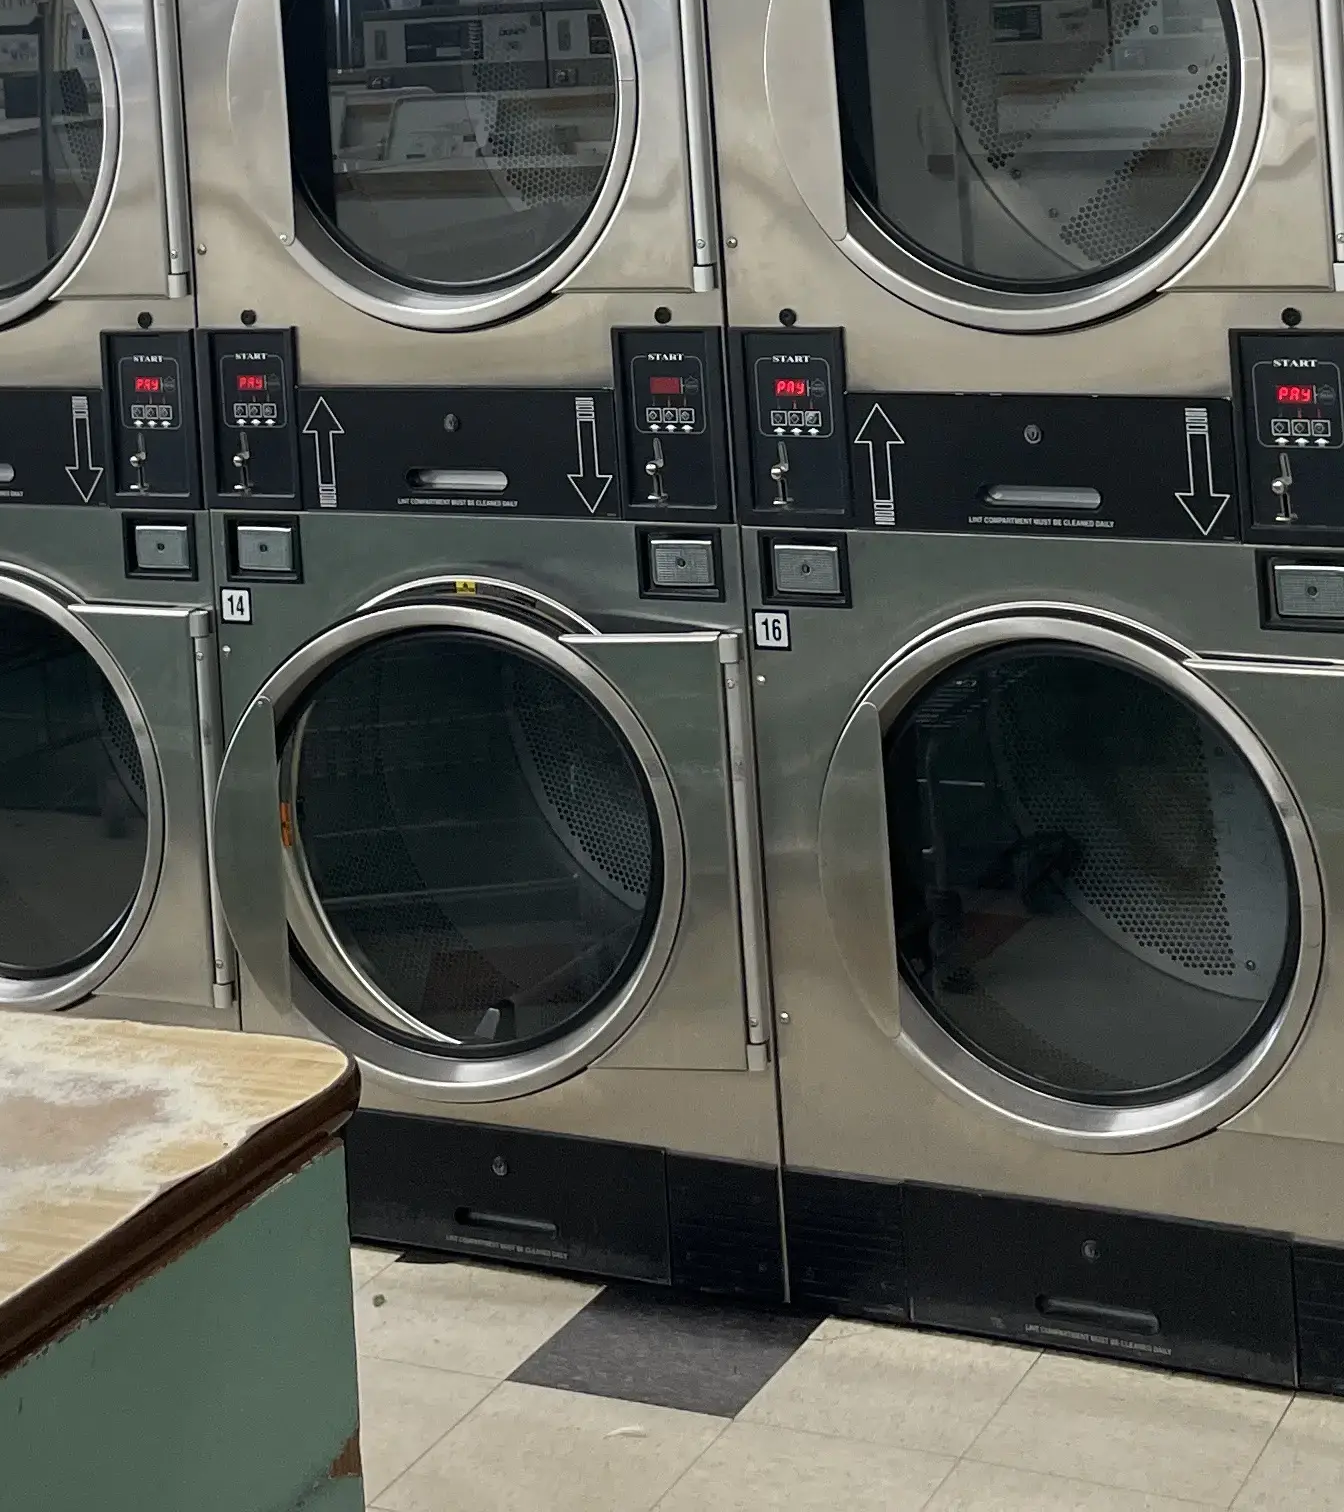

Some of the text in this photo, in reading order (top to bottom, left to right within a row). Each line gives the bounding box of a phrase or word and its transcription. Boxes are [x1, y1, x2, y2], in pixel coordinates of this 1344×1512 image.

[235, 352, 268, 360] START
[648, 353, 684, 361] START
[772, 354, 810, 363] START
[1272, 359, 1317, 368] START
[227, 594, 244, 616] 14
[761, 618, 782, 642] 16
